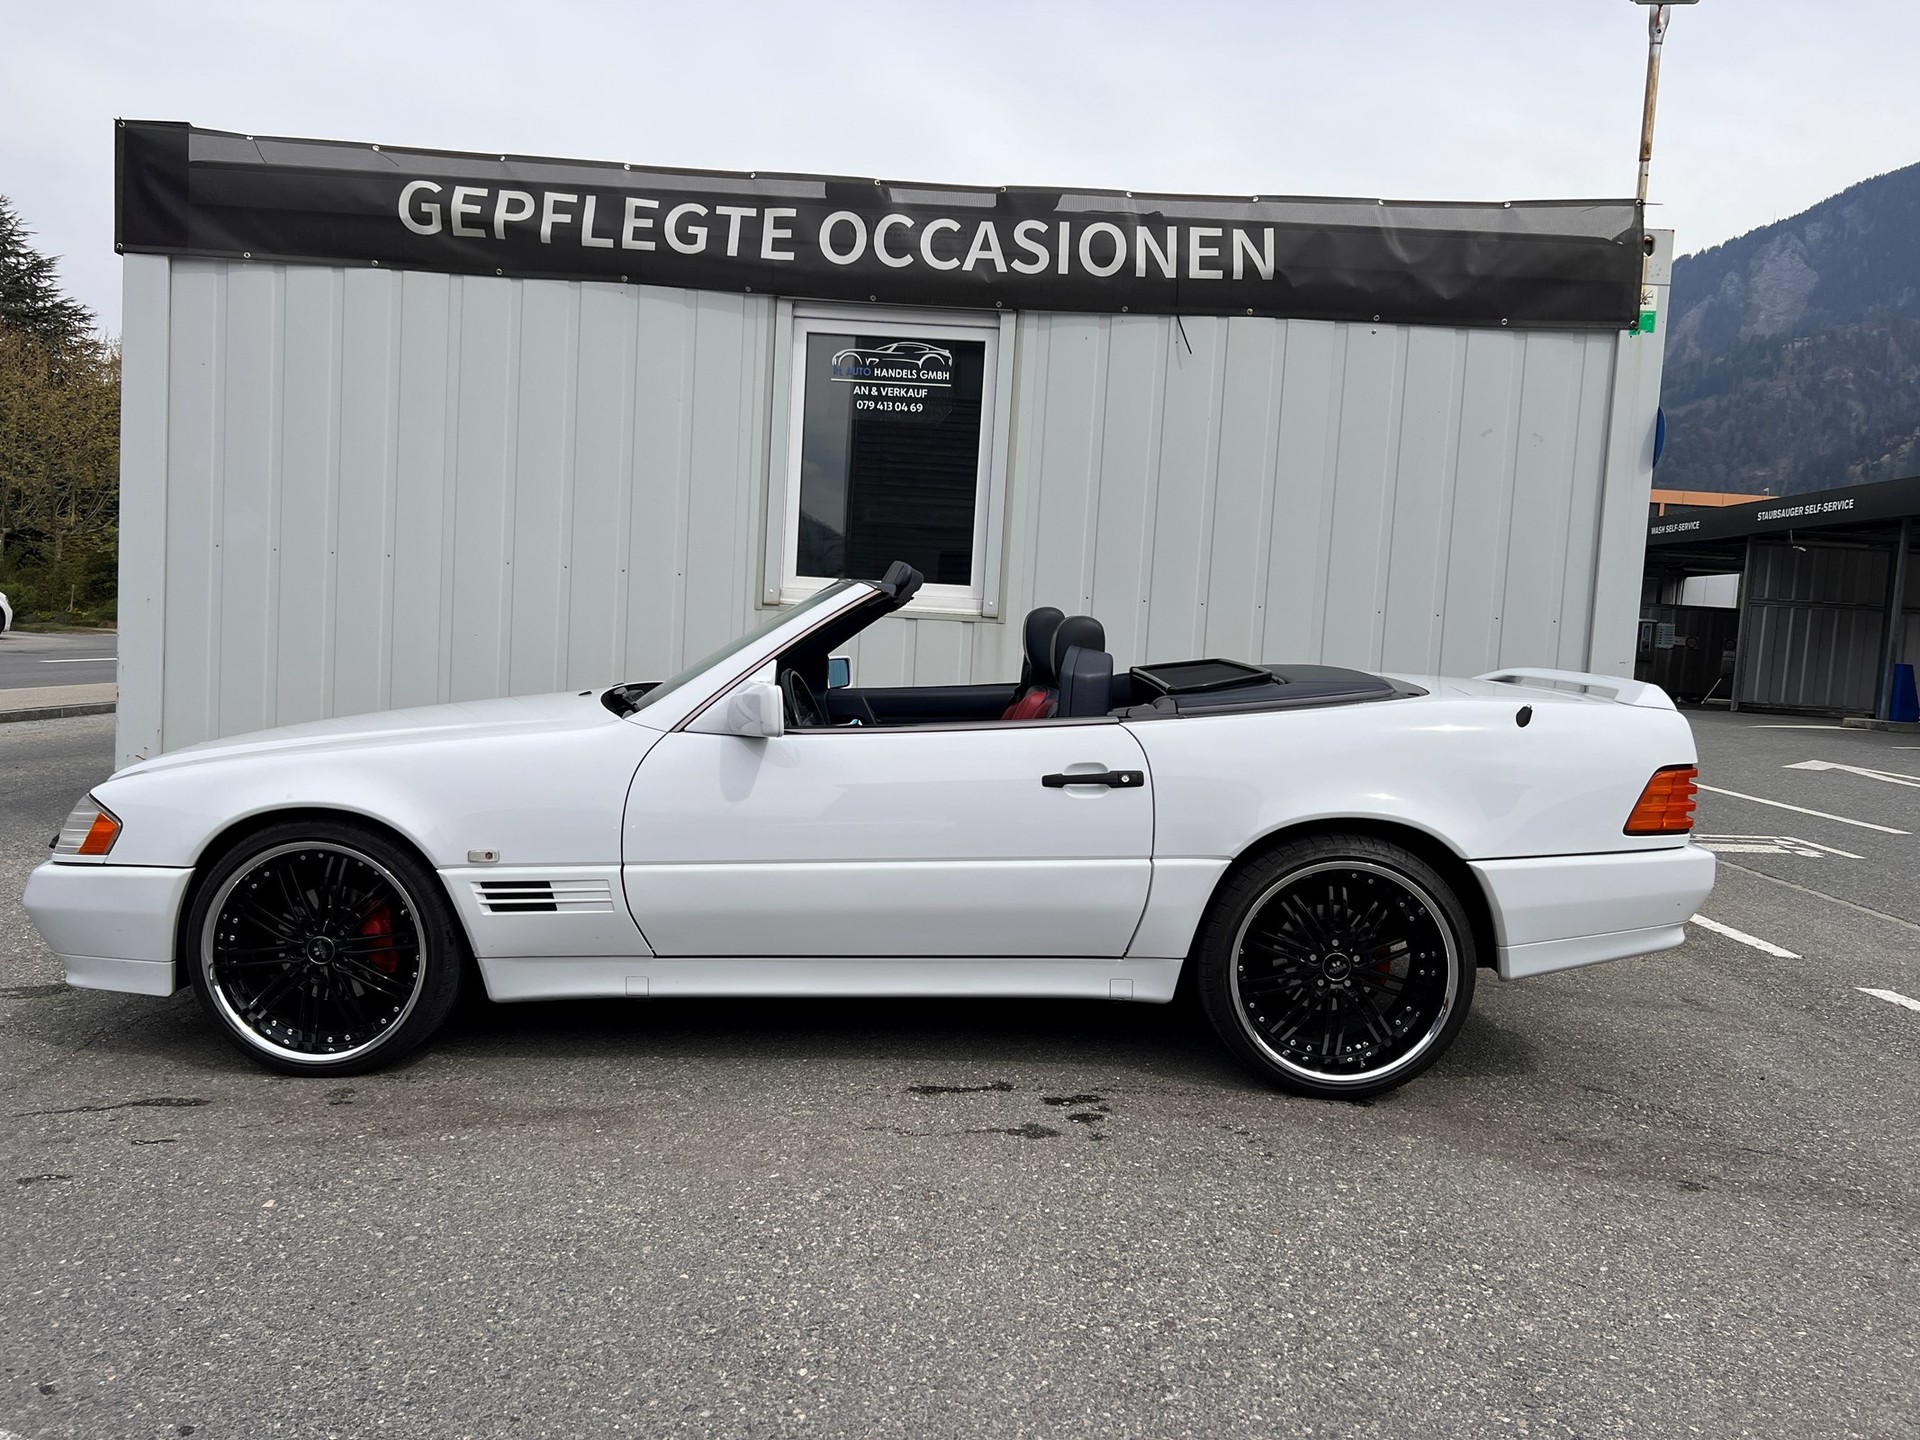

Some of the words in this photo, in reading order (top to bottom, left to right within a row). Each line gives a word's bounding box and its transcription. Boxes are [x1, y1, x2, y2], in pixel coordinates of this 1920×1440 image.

[398, 179, 798, 262] GEPFLEGTE
[818, 210, 1275, 281] OCCASIONEN
[846, 366, 872, 377] AUTO
[874, 367, 917, 379] HANDELS
[920, 370, 950, 381] GMBH
[853, 385, 869, 396] AN
[871, 386, 878, 396] &
[880, 387, 928, 398] VERKAUF
[856, 400, 875, 411] 079
[876, 401, 893, 411] 413
[894, 401, 908, 412] 04
[910, 402, 923, 412] 69
[1757, 505, 1804, 521] STAUBSAUGER
[1804, 498, 1855, 515] SELF-SERVICE
[1665, 521, 1700, 533] SELF-SERVICE
